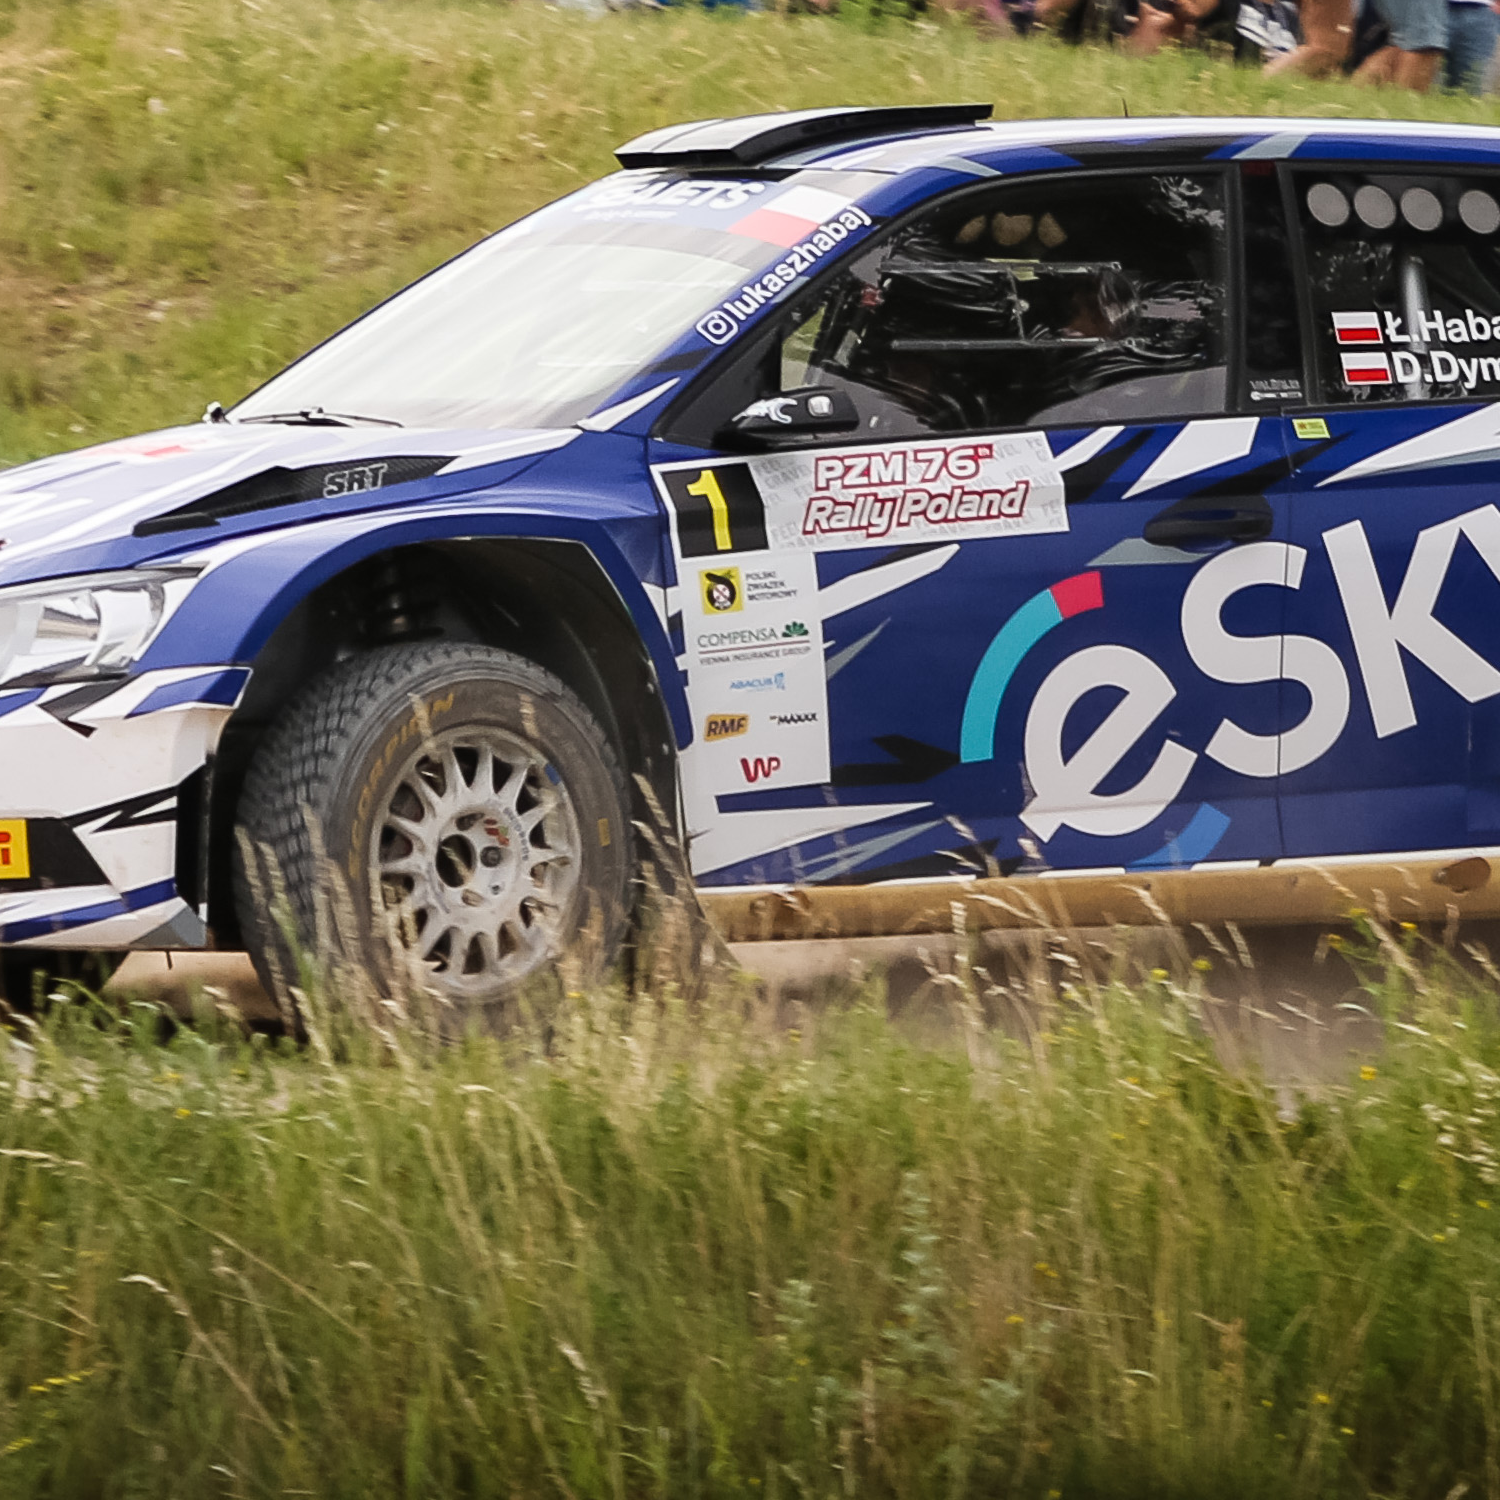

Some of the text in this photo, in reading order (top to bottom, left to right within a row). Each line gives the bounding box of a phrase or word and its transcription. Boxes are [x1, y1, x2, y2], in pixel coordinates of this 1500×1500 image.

[723, 205, 872, 320] lukaszhabaj
[323, 462, 389, 499] SRT
[814, 450, 908, 491] PZM
[687, 469, 732, 550] 1
[803, 491, 898, 538] Rally
[898, 481, 1030, 529] Poland
[697, 627, 778, 648] COMPENSA
[706, 716, 747, 738] RMF
[740, 756, 781, 783] WP
